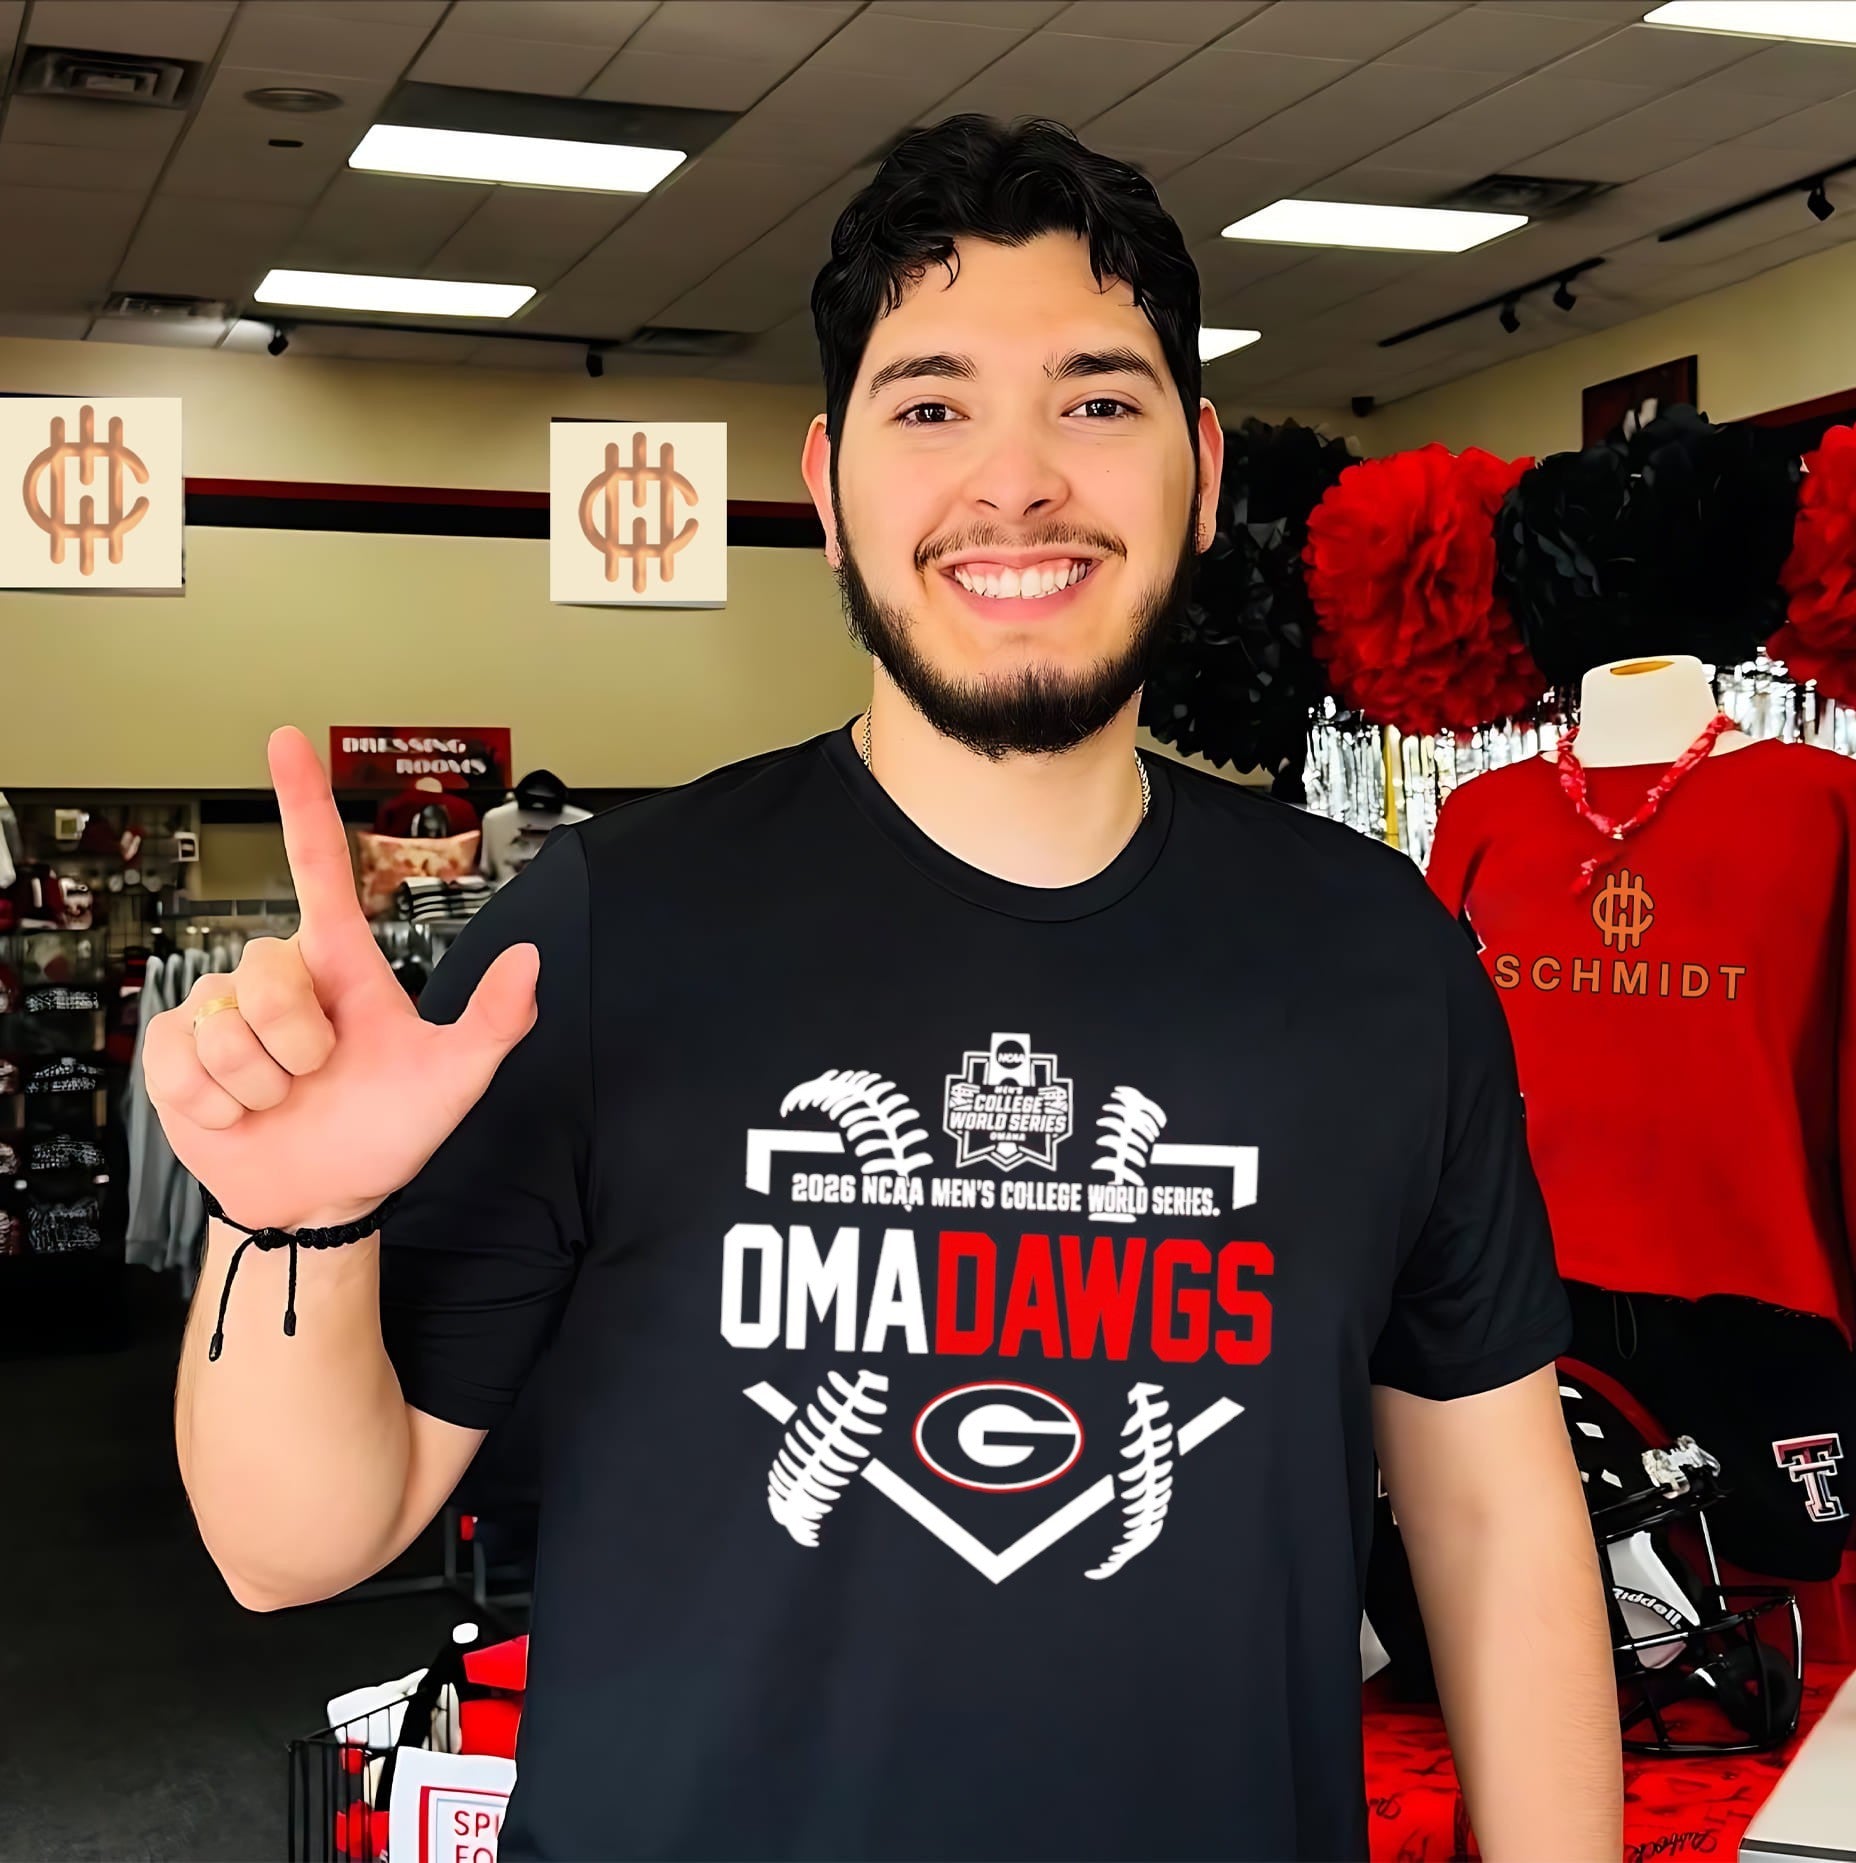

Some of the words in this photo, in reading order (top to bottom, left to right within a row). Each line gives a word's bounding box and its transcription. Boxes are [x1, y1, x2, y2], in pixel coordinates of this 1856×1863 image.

[342, 737, 467, 754] DRESSING
[396, 758, 487, 775] ROOMS
[1494, 954, 1746, 1001] SCHMIDT
[973, 1094, 1044, 1113] COLLEGE
[949, 1111, 1008, 1131] WORLD
[1008, 1113, 1068, 1133] SERIES
[791, 1172, 857, 1204] 2026
[861, 1175, 925, 1206] NCAA
[931, 1177, 996, 1209] MEN'S
[1001, 1180, 1083, 1213] COLLEGE
[1087, 1184, 1149, 1215] WORLD
[720, 1223, 1275, 1366] OMADAWGS
